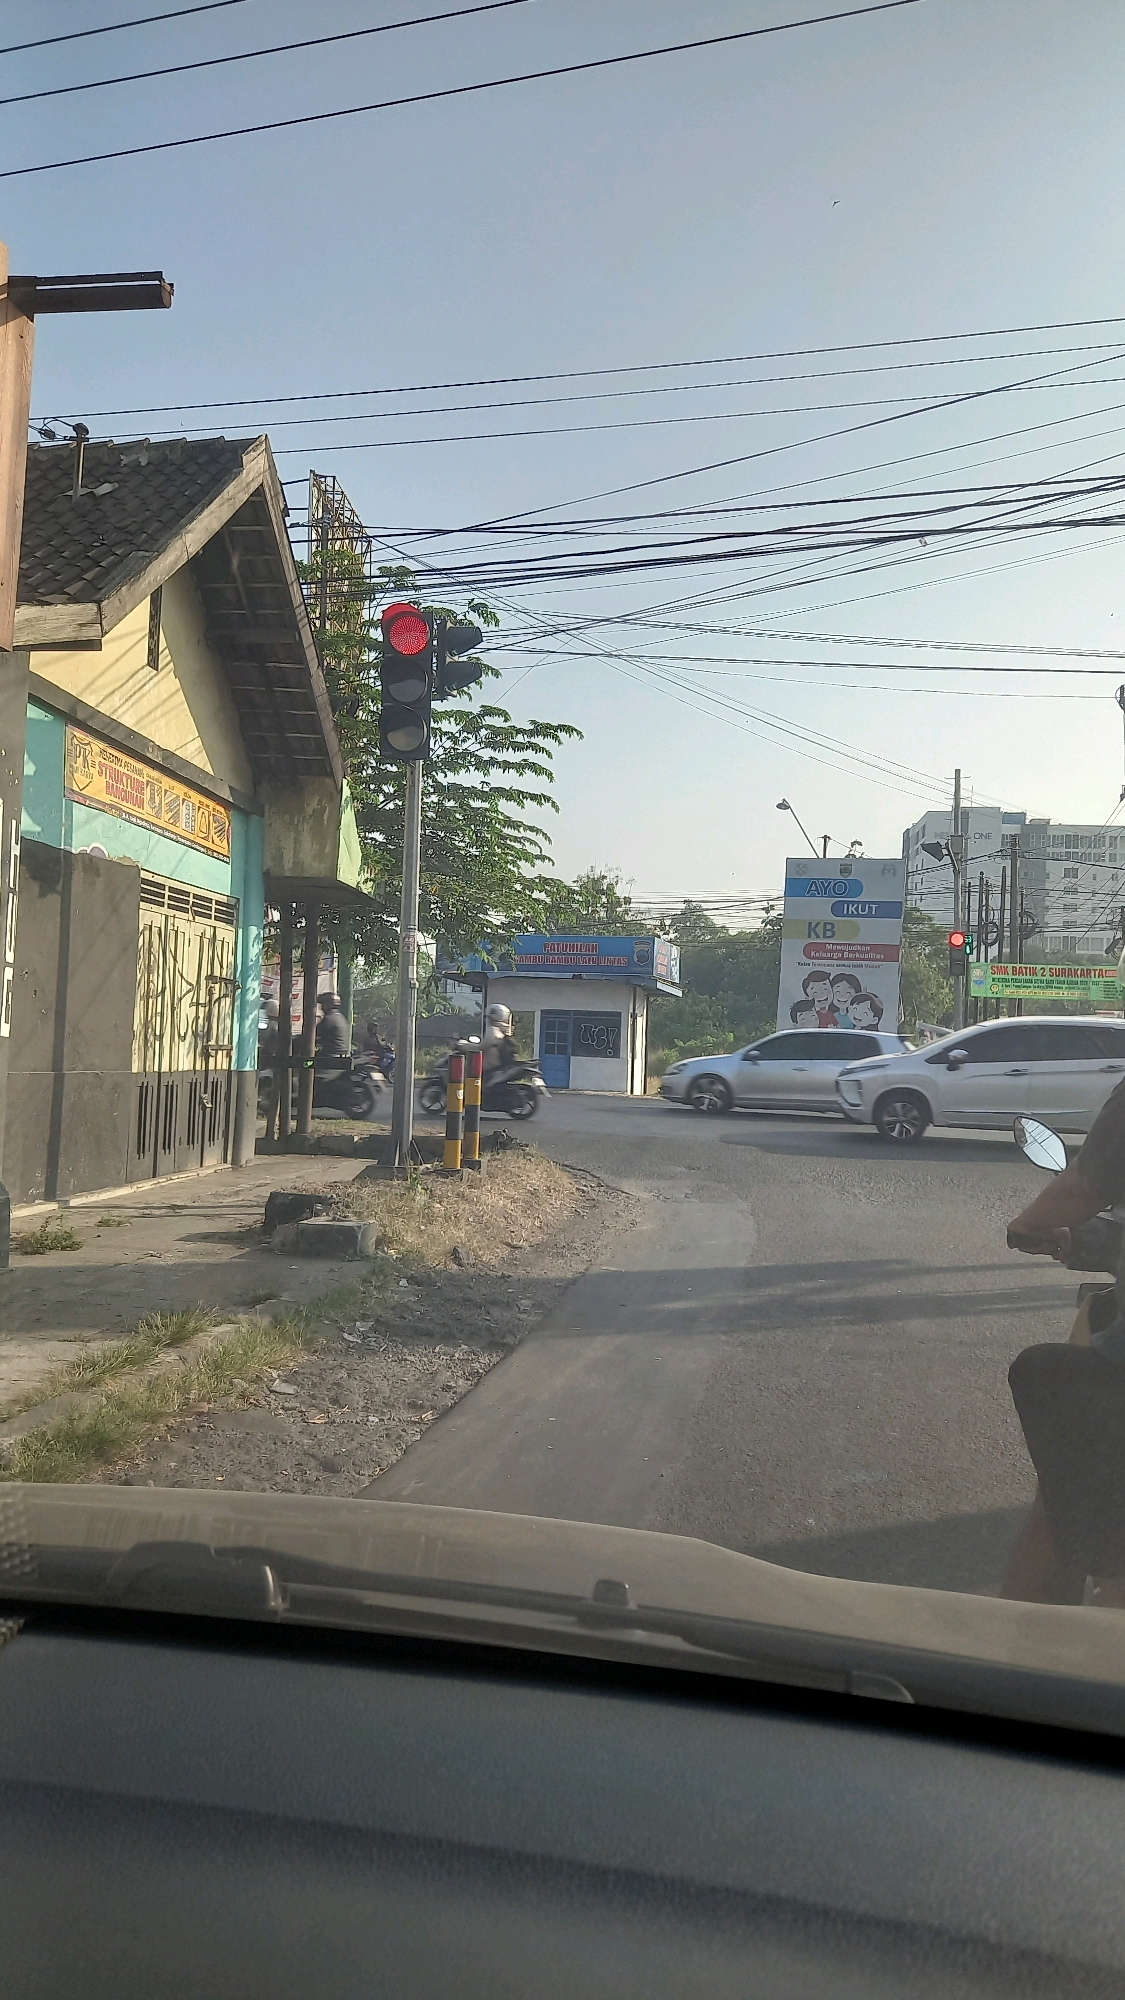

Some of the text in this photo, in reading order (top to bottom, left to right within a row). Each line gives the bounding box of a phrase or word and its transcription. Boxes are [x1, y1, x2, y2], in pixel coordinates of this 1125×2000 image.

[97, 760, 146, 797] STRUKTURE
[105, 780, 145, 811] BANGUNAN
[973, 831, 993, 840] ONE
[805, 879, 849, 897] AYO
[843, 903, 879, 915] IKUT
[807, 921, 836, 939] KB
[542, 941, 599, 954] PATUHILAH
[544, 955, 576, 966] RAMBU
[576, 956, 598, 966] LALU
[598, 956, 629, 967] LINTAS
[810, 950, 885, 960] Keluarga Berkualitas
[990, 965, 1009, 976] SMK
[1011, 966, 1038, 977] BATIK
[1039, 967, 1047, 977] 2
[1048, 967, 1105, 978] SURAKARTA
